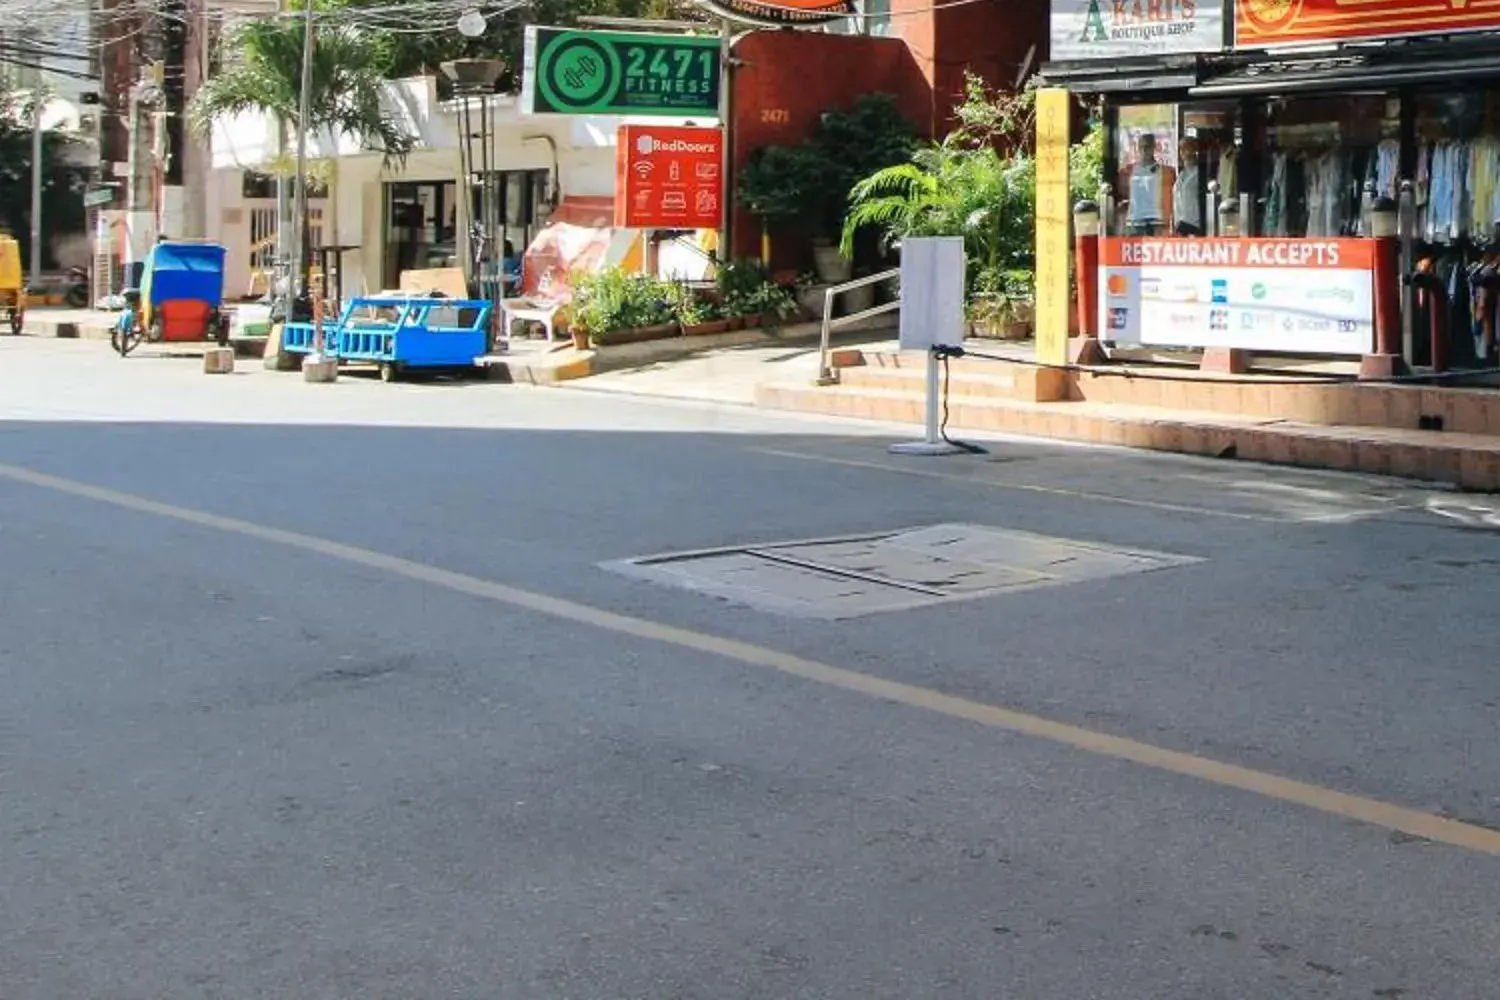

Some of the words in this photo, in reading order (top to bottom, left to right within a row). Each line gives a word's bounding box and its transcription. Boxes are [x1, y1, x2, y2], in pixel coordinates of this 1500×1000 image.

[627, 47, 713, 78] 2471
[626, 79, 711, 94] FITNESS
[1122, 242, 1240, 264] RESTAURANT
[1247, 242, 1339, 265] ACCEPTS
